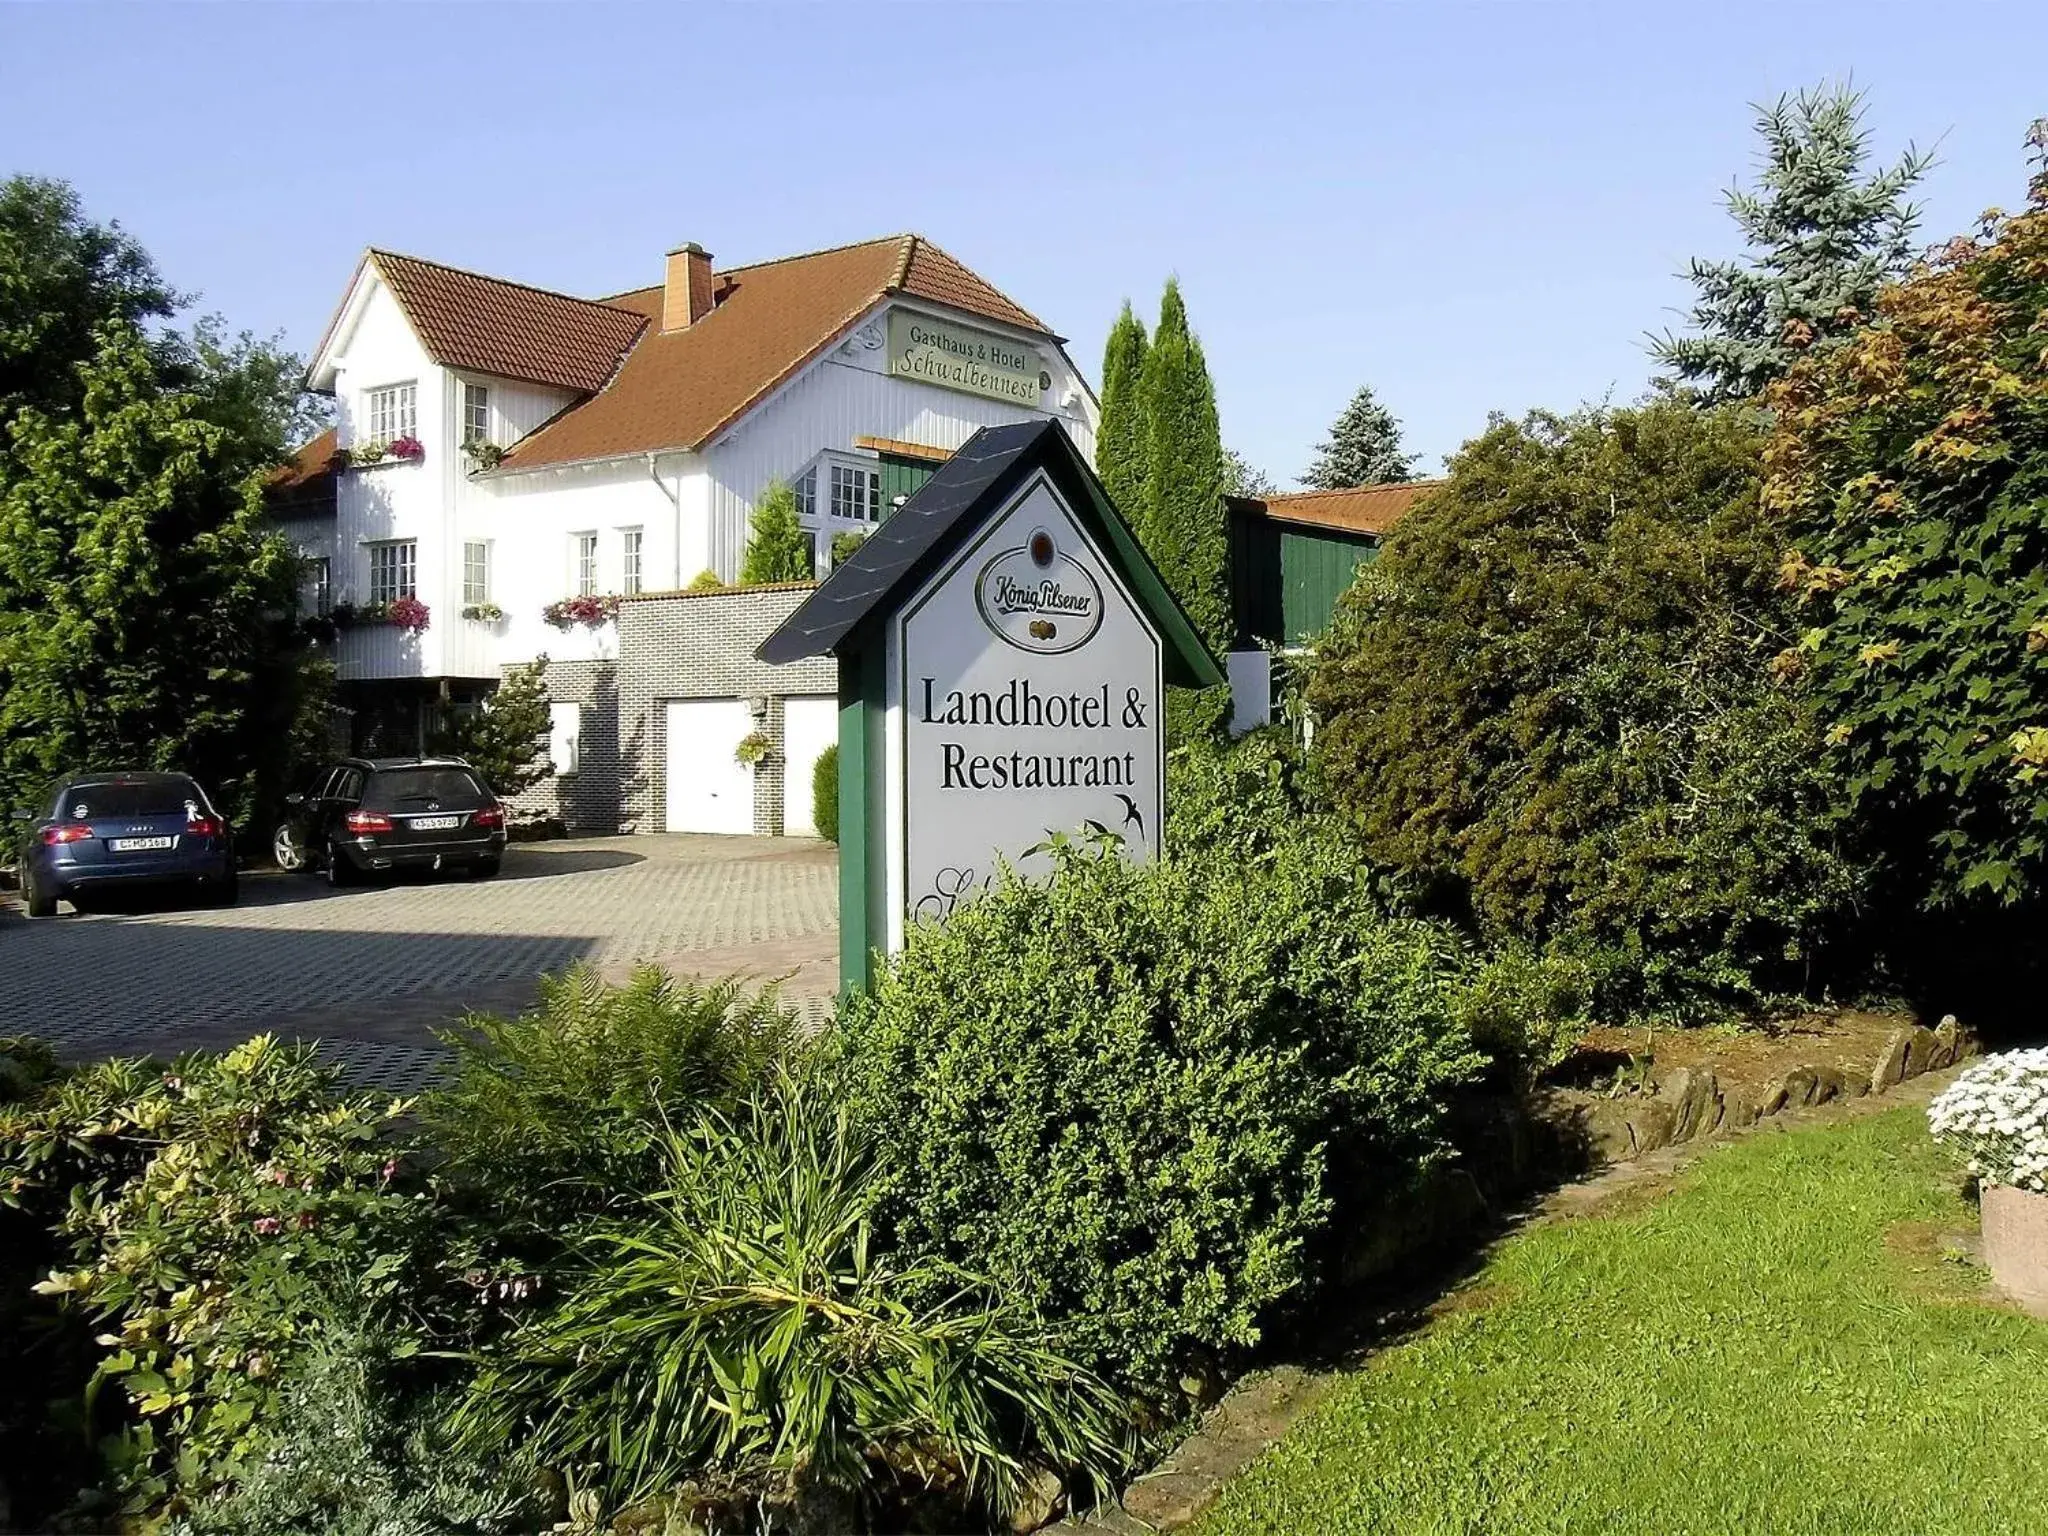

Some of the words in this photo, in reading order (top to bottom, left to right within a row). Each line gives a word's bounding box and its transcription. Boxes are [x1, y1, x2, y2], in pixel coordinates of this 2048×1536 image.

[910, 326, 974, 358] Gasthaus
[977, 343, 986, 359] &
[991, 346, 1026, 371] Hotel
[901, 349, 1034, 399] Schwalbennest
[993, 576, 1039, 612] König
[1039, 579, 1091, 612] Pilsener
[921, 677, 1111, 728] Landhotel
[1121, 687, 1148, 729] &
[940, 743, 1136, 790] Restaurant
